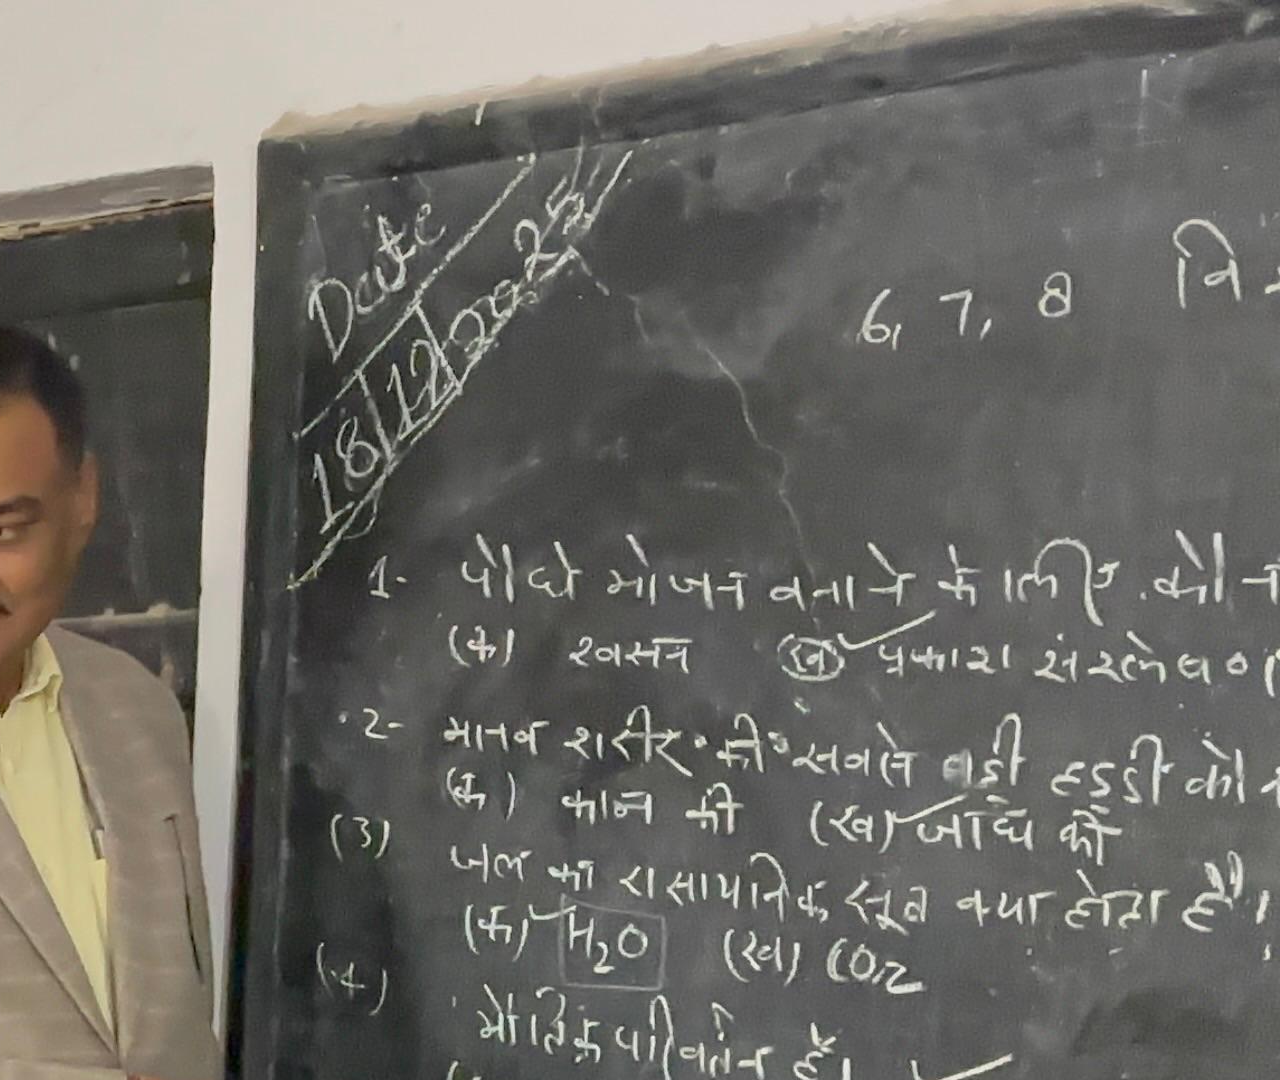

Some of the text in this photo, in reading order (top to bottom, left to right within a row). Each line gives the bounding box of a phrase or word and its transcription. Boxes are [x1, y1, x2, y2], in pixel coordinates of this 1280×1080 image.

[308, 203, 446, 363] Date
[1039, 271, 1072, 318] 8
[939, 544, 981, 606] के
[444, 716, 549, 755] मानव
[564, 705, 694, 777] शरीर
